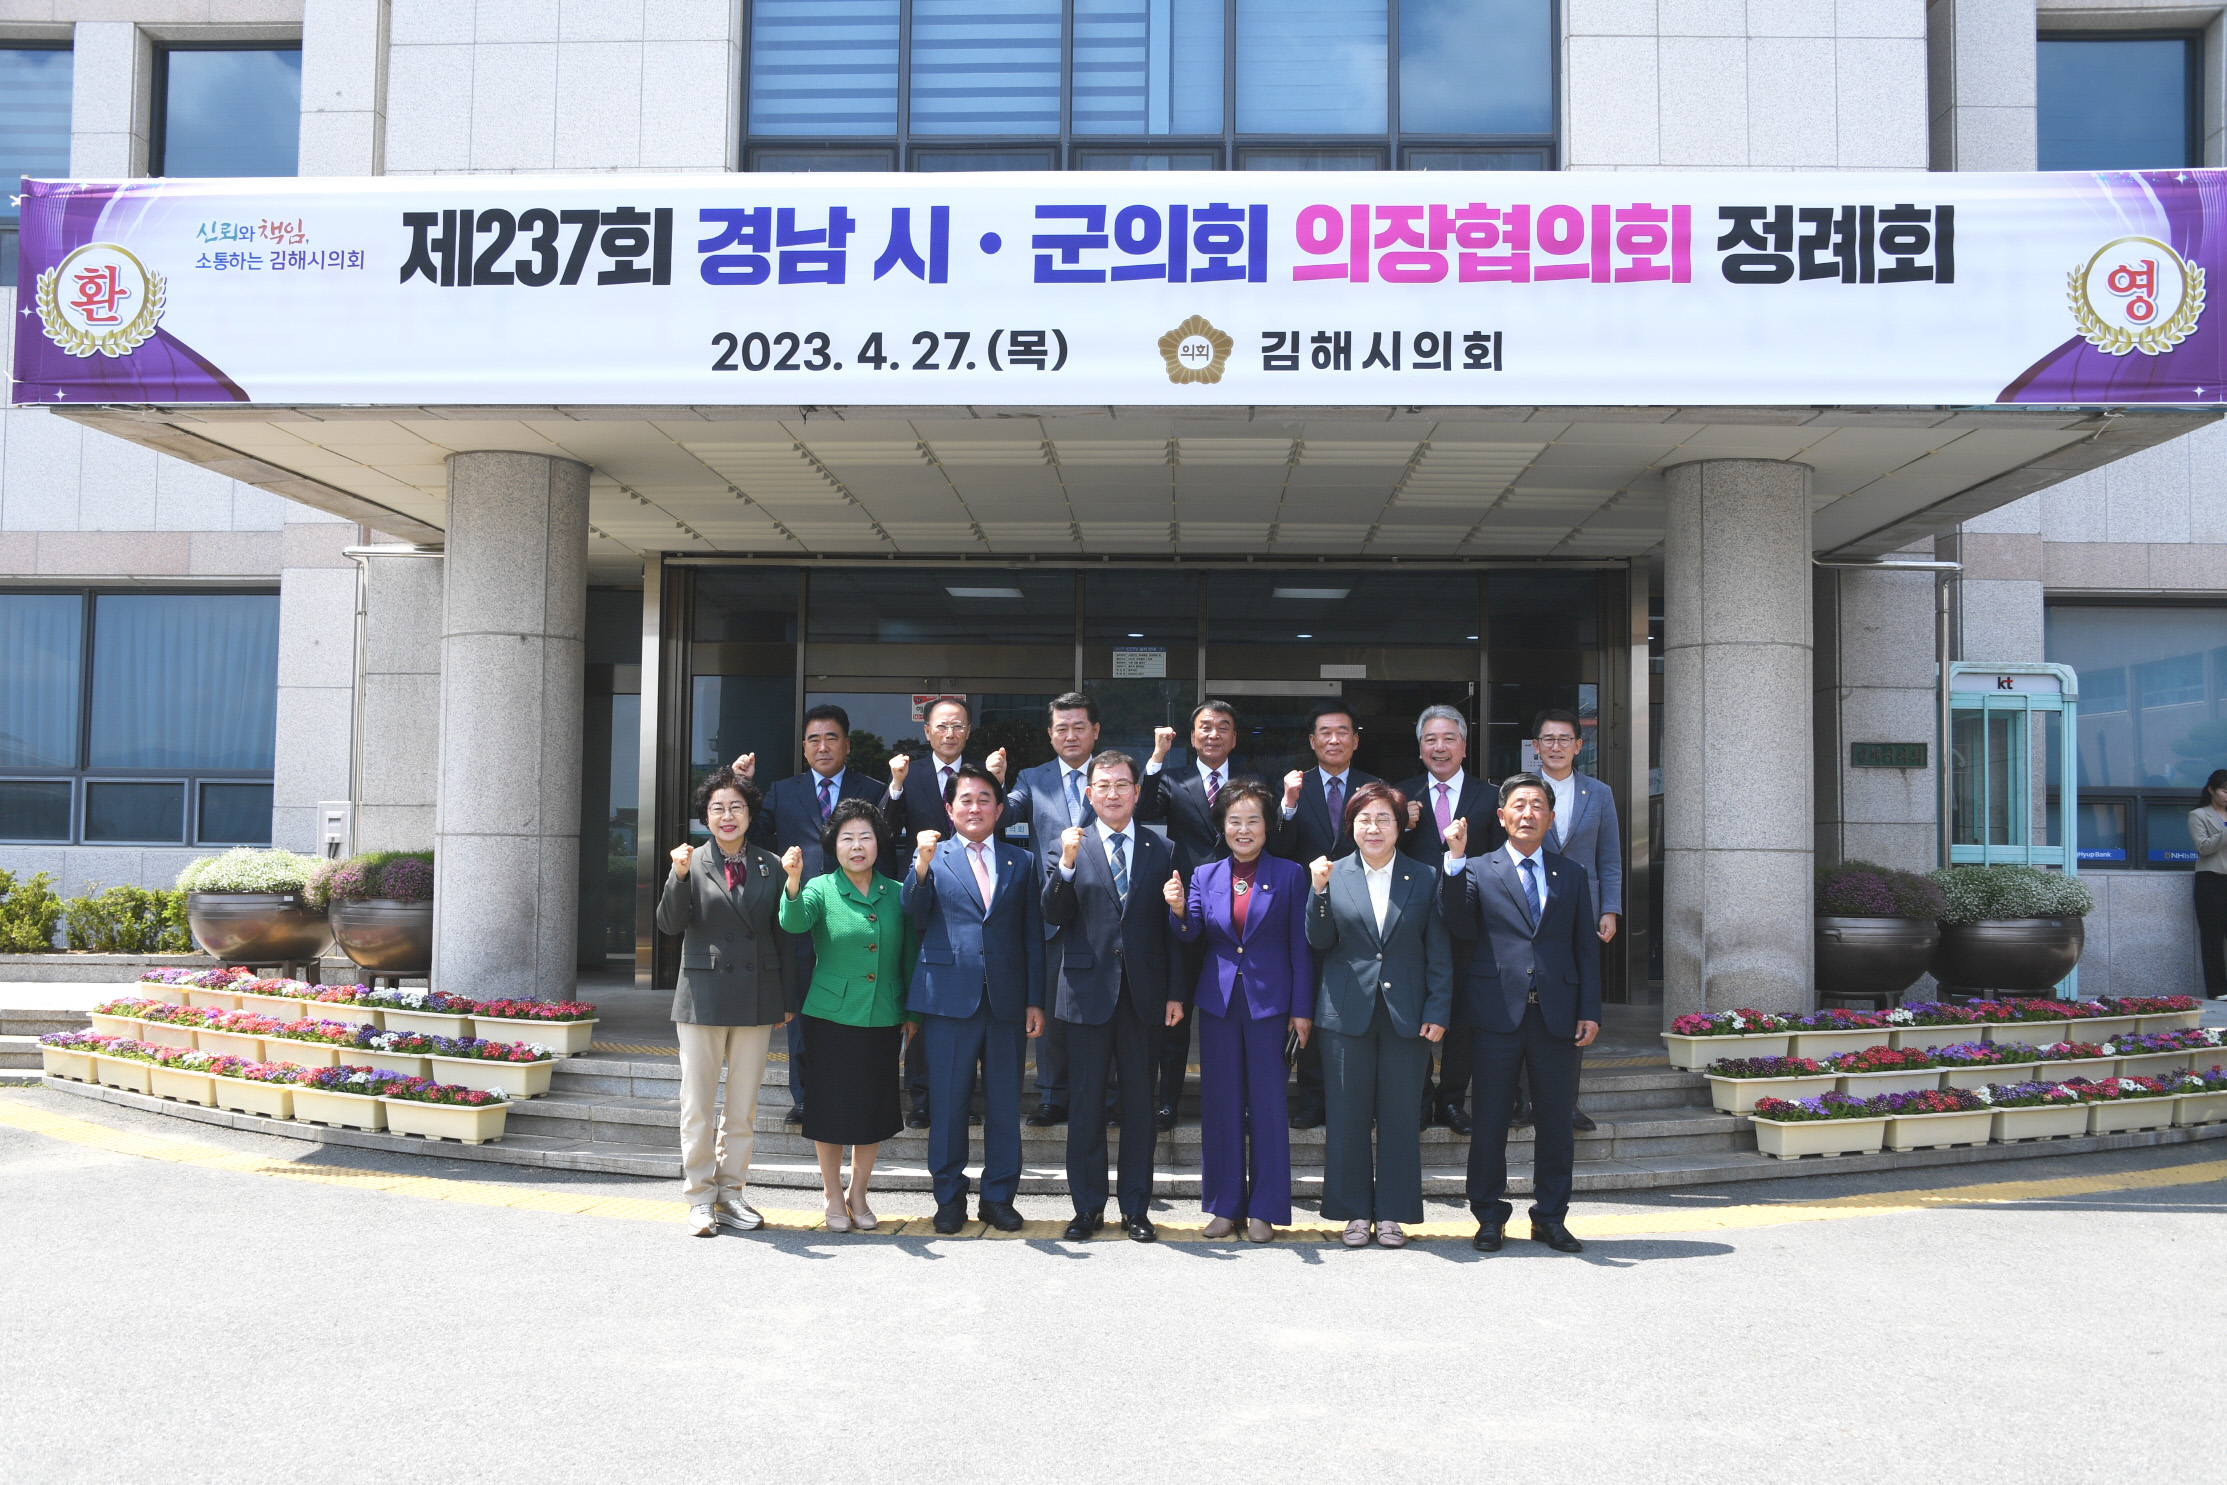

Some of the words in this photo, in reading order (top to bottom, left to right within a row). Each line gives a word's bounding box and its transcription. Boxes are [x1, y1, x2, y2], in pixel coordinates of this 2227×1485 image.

[196, 220, 256, 244] 신뢰와
[257, 218, 310, 245] 책임,
[400, 206, 673, 287] 제237회
[697, 205, 855, 285] 경남
[874, 205, 949, 284] 시
[1032, 203, 1268, 284] 군의회
[1292, 202, 1692, 284] 의장협의회
[1716, 203, 1955, 285] 정례회
[195, 251, 264, 271] 소통하는
[269, 249, 365, 271] 김해시의회
[70, 264, 126, 322] 환
[2108, 259, 2156, 322] 영
[711, 331, 843, 372] 2023.
[857, 331, 900, 371] 4.
[1180, 344, 1209, 361] 의회
[1261, 330, 1503, 372] 김해시의회
[1997, 676, 2014, 690] kt
